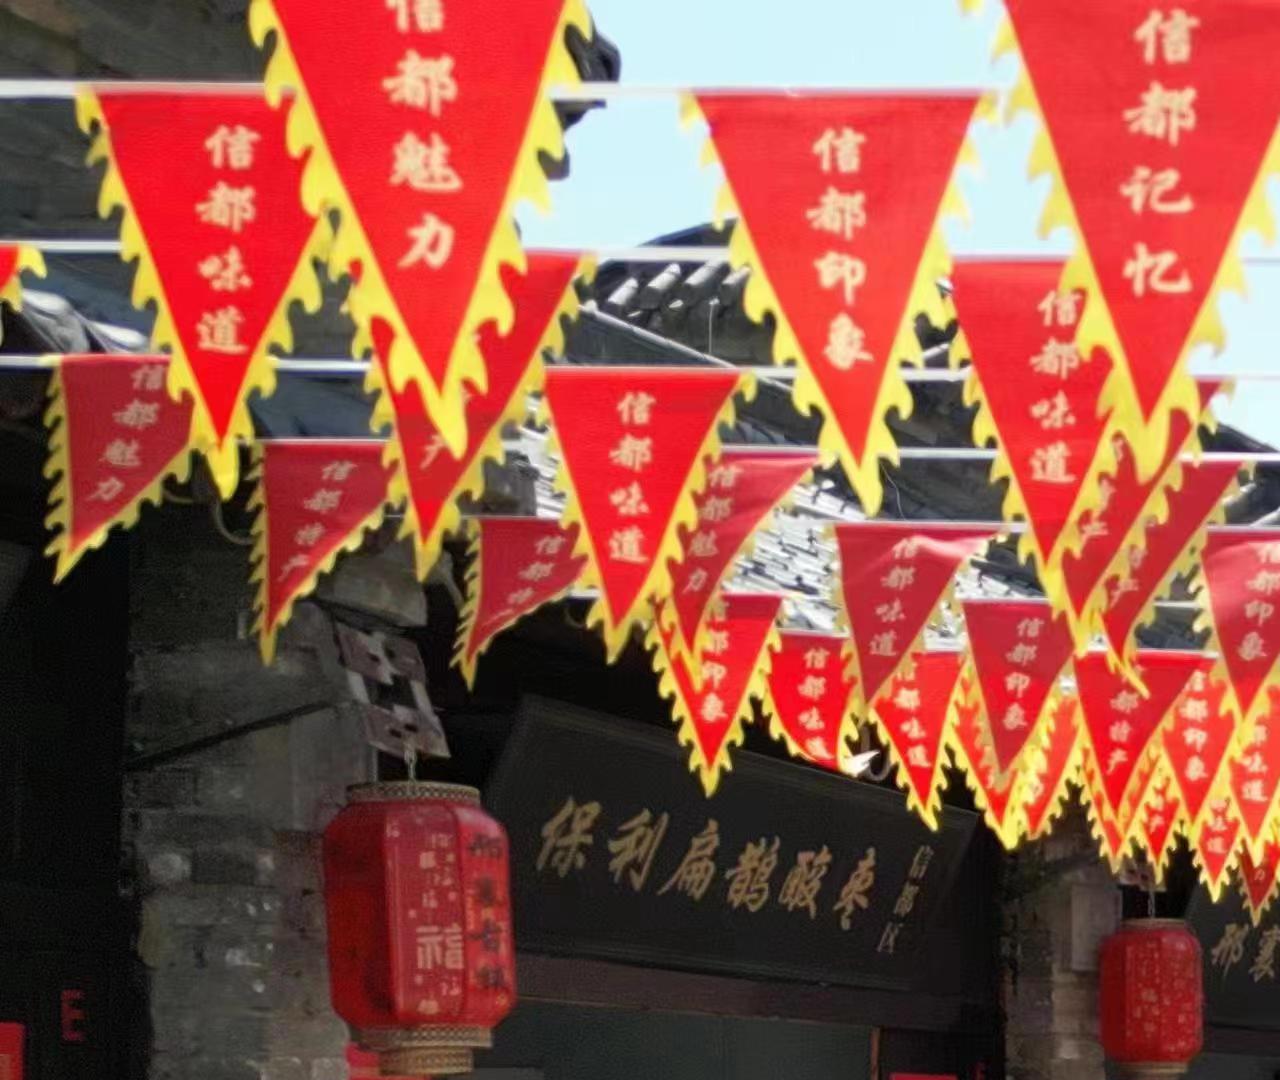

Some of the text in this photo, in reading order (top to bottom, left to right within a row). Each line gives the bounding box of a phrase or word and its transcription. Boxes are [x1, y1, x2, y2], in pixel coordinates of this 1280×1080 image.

[1120, 10, 1199, 298] 信都记忆
[195, 124, 262, 355] 信都味道
[806, 128, 874, 370] 信都印象
[90, 365, 163, 500] 信都魅力
[1029, 290, 1082, 484] 信都味道
[278, 460, 357, 581] 信都特产
[608, 392, 657, 564] 信都味道
[683, 464, 741, 596] 信都魅力
[1002, 617, 1043, 730] 信都印象
[536, 797, 880, 931] 保利扁鹊酸枣
